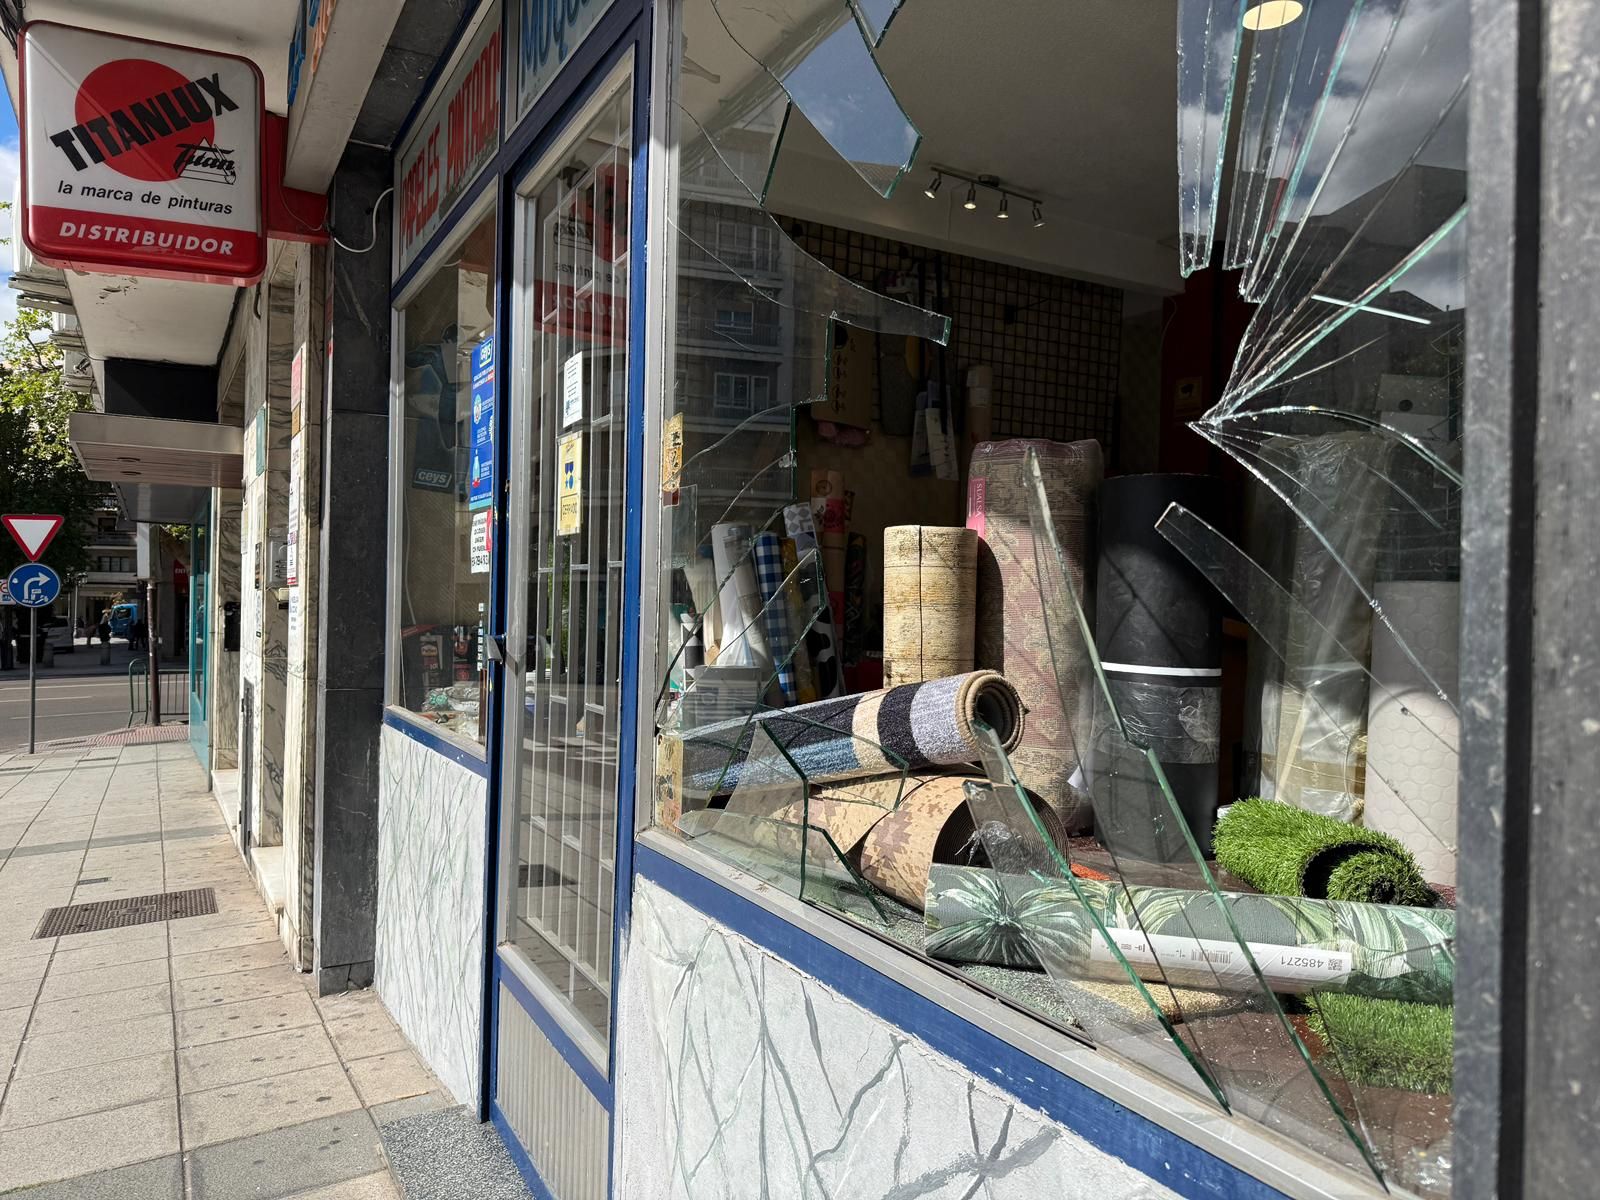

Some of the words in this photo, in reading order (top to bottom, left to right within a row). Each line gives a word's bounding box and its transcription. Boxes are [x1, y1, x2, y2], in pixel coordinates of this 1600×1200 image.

[50, 73, 239, 171] TITANLUX
[172, 144, 234, 174] Titan
[58, 180, 73, 194] la
[81, 186, 133, 201] marca
[141, 191, 161, 205] de
[168, 195, 233, 215] pinturas
[59, 222, 234, 256] DISTRIBUIDOR
[418, 471, 447, 484] ceys
[1281, 956, 1324, 969] 485271
